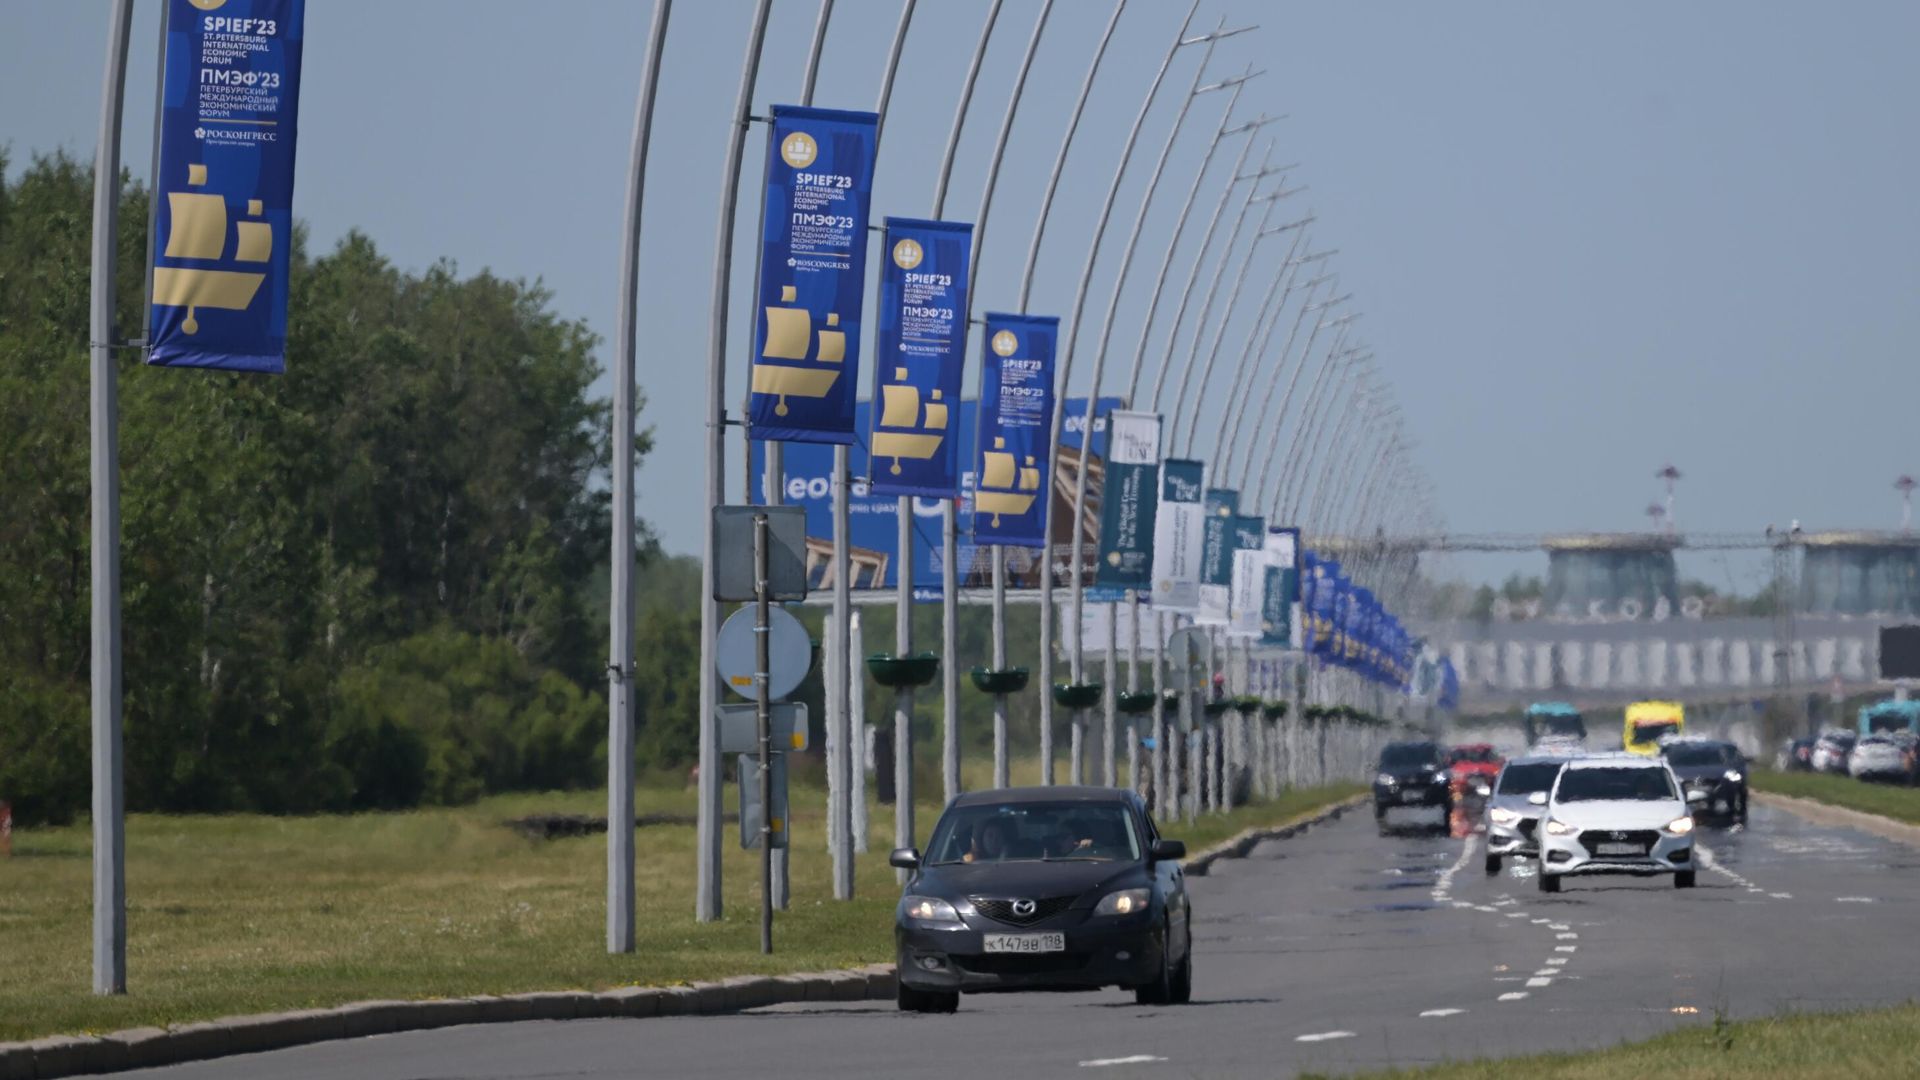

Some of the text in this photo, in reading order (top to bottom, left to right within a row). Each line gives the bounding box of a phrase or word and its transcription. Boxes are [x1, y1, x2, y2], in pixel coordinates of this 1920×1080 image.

[216, 33, 266, 43] PETERSBURG
[203, 41, 270, 52] INTERNATIONAL
[203, 48, 247, 58] ECONOMIC
[202, 56, 232, 64] FORUM
[200, 85, 268, 96] ПЕТЕРБУРГСКИЙ
[200, 93, 278, 104] МЕЖДУНАРОДНЫЙ
[200, 101, 276, 112] ЭКОНОМИЧЕСКИЙ
[206, 129, 276, 141] РОСКОНГРЕСС
[806, 186, 844, 194] PETERSBURG
[794, 192, 846, 200] INTERNATIONAL
[792, 225, 844, 234] ПЕТЕРБУРГСКИЙ
[792, 231, 852, 241] МЕЖДУНАРОДНЫЙ
[791, 238, 850, 247] ЭКОНОМИЧЕСКИЙ
[796, 260, 850, 269] ROSCONGRESS
